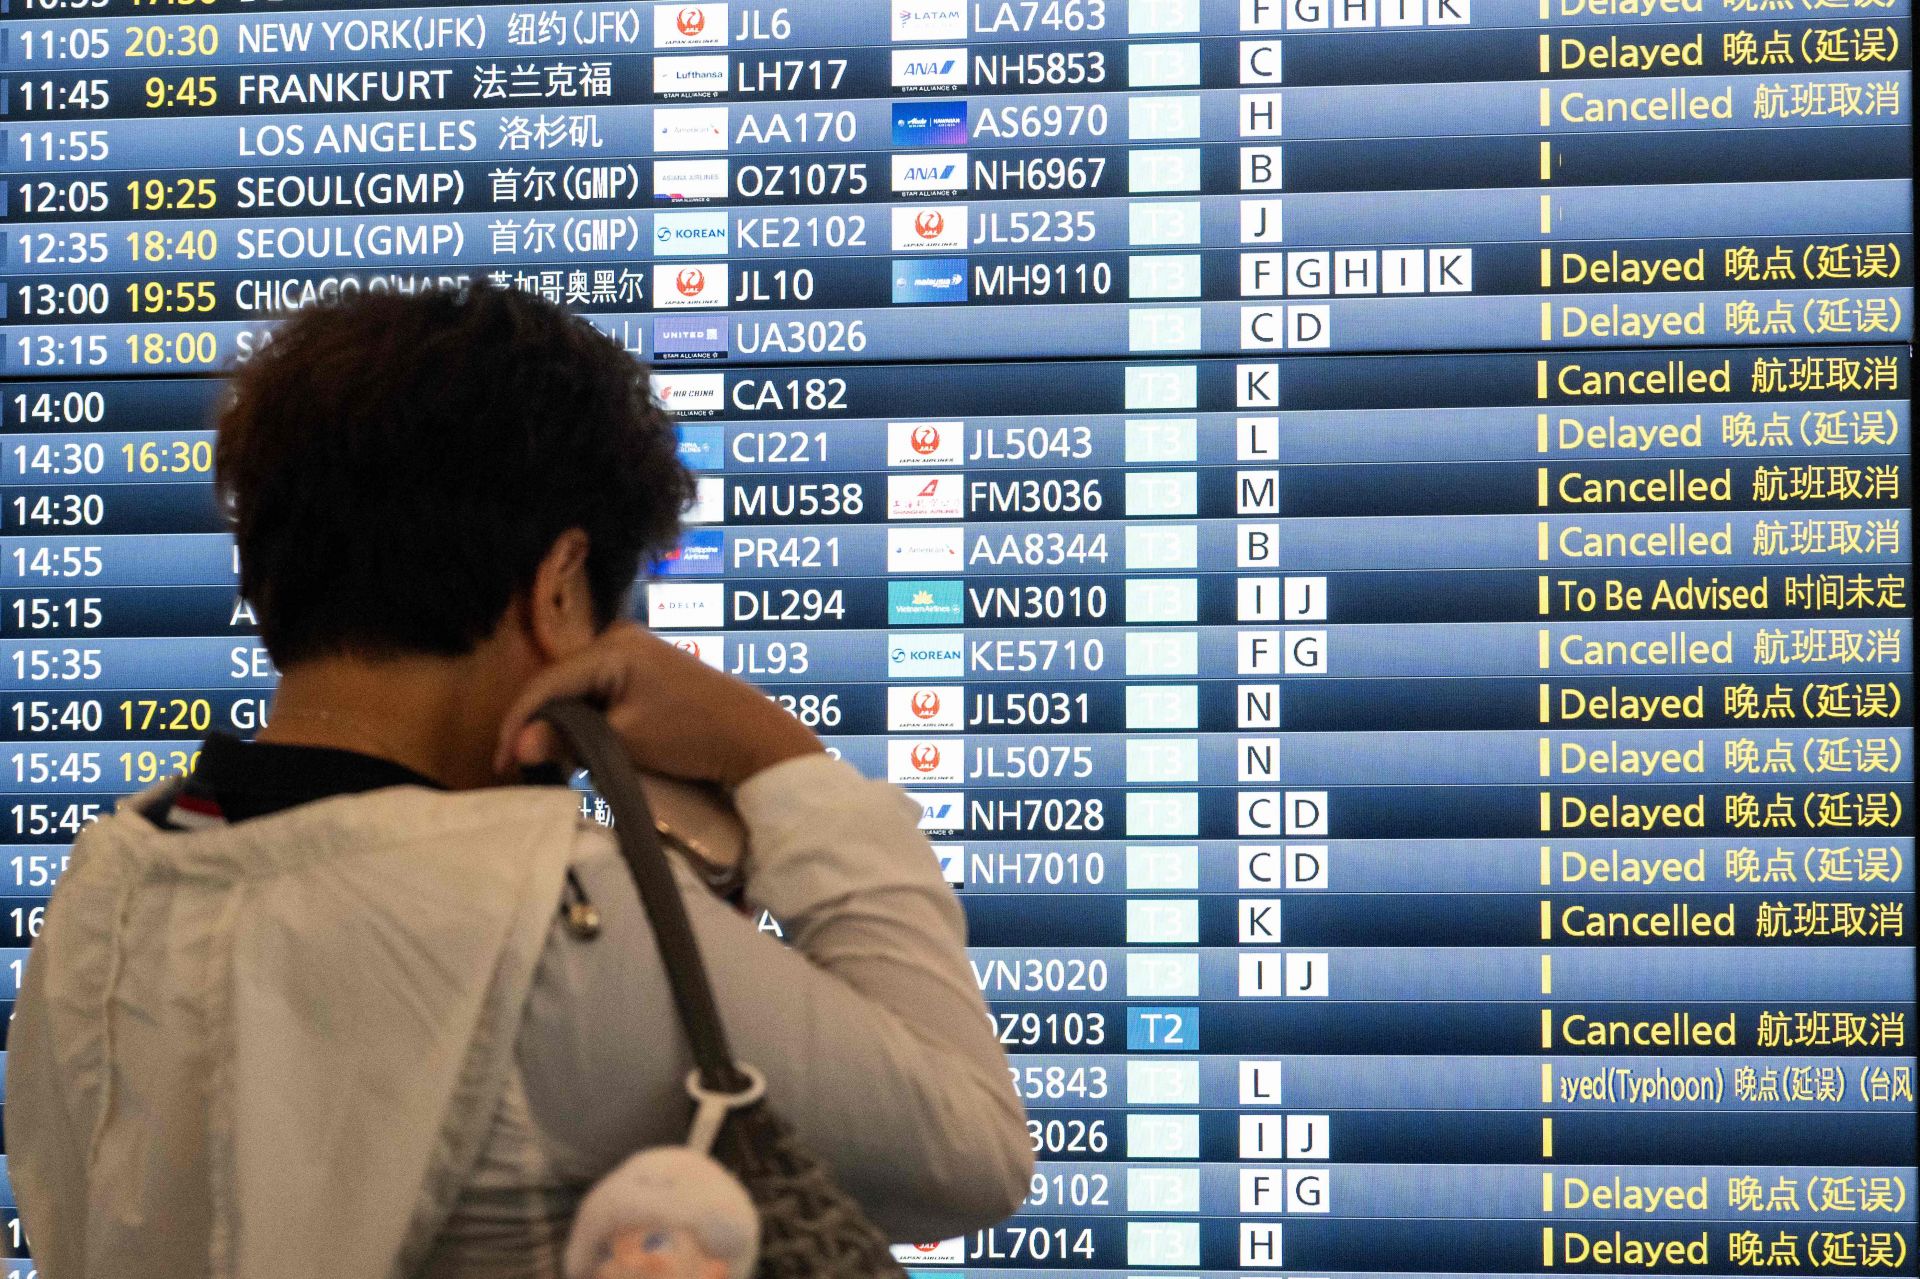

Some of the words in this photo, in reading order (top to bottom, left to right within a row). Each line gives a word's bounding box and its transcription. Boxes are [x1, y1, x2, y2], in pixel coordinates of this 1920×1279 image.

[240, 23, 313, 52] NEW
[322, 11, 485, 50] YORK(JFK)
[508, 8, 639, 45] 纽约(JFK)
[736, 8, 790, 40] JL6
[914, 11, 959, 20] LATAM
[975, 0, 1105, 32] LA7463
[21, 29, 109, 59] 11:05
[125, 25, 218, 56] 20:30
[1562, 34, 1702, 69] Delayed
[1724, 27, 1898, 65] 晚点(延误)
[240, 70, 453, 105] FRANKFURT
[474, 63, 611, 98] 法兰克福
[676, 71, 723, 79] Lufthansa
[739, 60, 846, 91] LH717
[904, 63, 938, 76] ANA
[976, 52, 1104, 85] NH5853
[21, 80, 108, 110] 11:45
[146, 77, 216, 107] 9:45
[1561, 86, 1732, 122] Cancelled
[1754, 81, 1898, 118] 航班取消
[240, 125, 304, 155] LOS
[314, 120, 476, 153] ANGELES
[499, 115, 602, 150] 洛杉矶
[736, 111, 856, 143] AA170
[973, 104, 1107, 137] AS6970
[20, 131, 108, 161] 11:55
[238, 171, 463, 207] SEOUL(GMP)
[489, 164, 638, 202] 首尔(GMP)
[737, 164, 866, 196] OZ1075
[904, 166, 938, 180] ANA
[976, 158, 1105, 189] NH6967
[20, 182, 107, 211] 12:05
[128, 179, 216, 209] 19:25
[238, 222, 463, 259] SEOUL(GMP)
[488, 212, 638, 254] 首尔(GMP)
[675, 229, 726, 239] KOREAN
[738, 216, 866, 247] KE2102
[974, 211, 1095, 243] JL5235
[20, 233, 107, 263] 12:35
[127, 230, 216, 261] 18:40
[976, 263, 1110, 295] MH9110
[1255, 260, 1270, 290] F
[1296, 258, 1321, 288] G
[1345, 258, 1368, 287] H
[1440, 255, 1463, 286] K
[1563, 249, 1703, 284] Delayed
[1726, 243, 1899, 280] 晚点(延误)
[20, 284, 108, 314] 13:00
[127, 282, 215, 312] 19:55
[736, 269, 813, 301] JL10
[1563, 303, 1704, 338] Delayed
[1726, 297, 1900, 334] 晚点(延误)
[19, 336, 107, 365] 13:15
[127, 332, 216, 363] 18:00
[662, 331, 704, 339] UNITED
[738, 320, 866, 353] UA3026
[1248, 371, 1270, 401] K
[1559, 360, 1729, 394] Cancelled
[1752, 356, 1897, 392] 航班取消
[15, 392, 103, 422] 14:00
[673, 390, 687, 398] AIR
[689, 389, 714, 397] CHINA
[733, 379, 846, 409] CA182
[970, 427, 1091, 459] JL5043
[1560, 415, 1701, 450] Delayed
[1723, 410, 1897, 446] 晚点(延误)
[15, 443, 103, 474] 14:30
[122, 441, 211, 472] 16:30
[733, 432, 826, 462] CI221
[735, 484, 863, 515] MU538
[972, 480, 1101, 511] FM3036
[1242, 478, 1274, 507] M
[1560, 469, 1730, 502] Cancelled
[1753, 465, 1898, 501] 航班取消
[14, 495, 103, 525] 14:30
[735, 537, 838, 567] PR421
[970, 533, 1108, 564] AA8344
[1560, 523, 1731, 556] Cancelled
[1753, 519, 1898, 555] 航班取消
[14, 547, 101, 576] 14:55
[735, 590, 844, 620] DL294
[970, 586, 1106, 617] VN3010
[1558, 581, 1595, 611] To
[1607, 581, 1642, 610] Be
[1652, 577, 1767, 609] Advised
[1786, 574, 1905, 609] 时间未定
[14, 599, 101, 628] 15:15
[732, 642, 808, 674] JL93
[910, 650, 961, 660] KOREAN
[972, 639, 1103, 671] KE5710
[1252, 638, 1268, 668] F
[1293, 637, 1318, 667] G
[1560, 631, 1732, 664] Cancelled
[1754, 628, 1900, 664] 航班取消
[13, 649, 101, 679] 15:35
[13, 701, 101, 731] 15:40
[121, 700, 210, 729] 17:20
[766, 695, 840, 726] 386
[970, 693, 1087, 724] JL5031
[1562, 686, 1703, 721] Delayed
[1725, 683, 1900, 718] 晚点(延误)
[12, 753, 100, 782] 15:45
[970, 746, 1092, 777] JL5075
[1562, 740, 1703, 775] Delayed
[1725, 737, 1901, 773] 晚点(延误)
[972, 800, 1103, 830] NH7028
[1563, 795, 1704, 830] Delayed
[1726, 792, 1901, 827] 晚点(延误)
[11, 856, 68, 886] 15:
[972, 853, 1103, 884] NH7010
[1249, 852, 1272, 882] C
[1295, 853, 1320, 882] D
[1563, 849, 1704, 884] Delayed
[1726, 847, 1902, 882] 晚点(延误)
[1563, 904, 1734, 935] Cancelled
[1757, 902, 1902, 937] 航班取消
[970, 960, 1107, 991] VN3020
[1141, 1013, 1183, 1043] T2
[1563, 1013, 1735, 1045] Cancelled
[1758, 1011, 1903, 1046] 航班取消
[1008, 1067, 1107, 1098] R5843
[1254, 1068, 1270, 1098] L
[1735, 1066, 1843, 1101] 晚点(延误)
[1861, 1067, 1912, 1101] (台风
[1565, 1177, 1707, 1212] Delayed
[1729, 1176, 1905, 1212] 晚点(延误)
[971, 1228, 1094, 1258] JL7014
[1250, 1230, 1273, 1260] H
[1566, 1232, 1707, 1266] Delayed
[1730, 1231, 1905, 1267] 晚点(延误)
